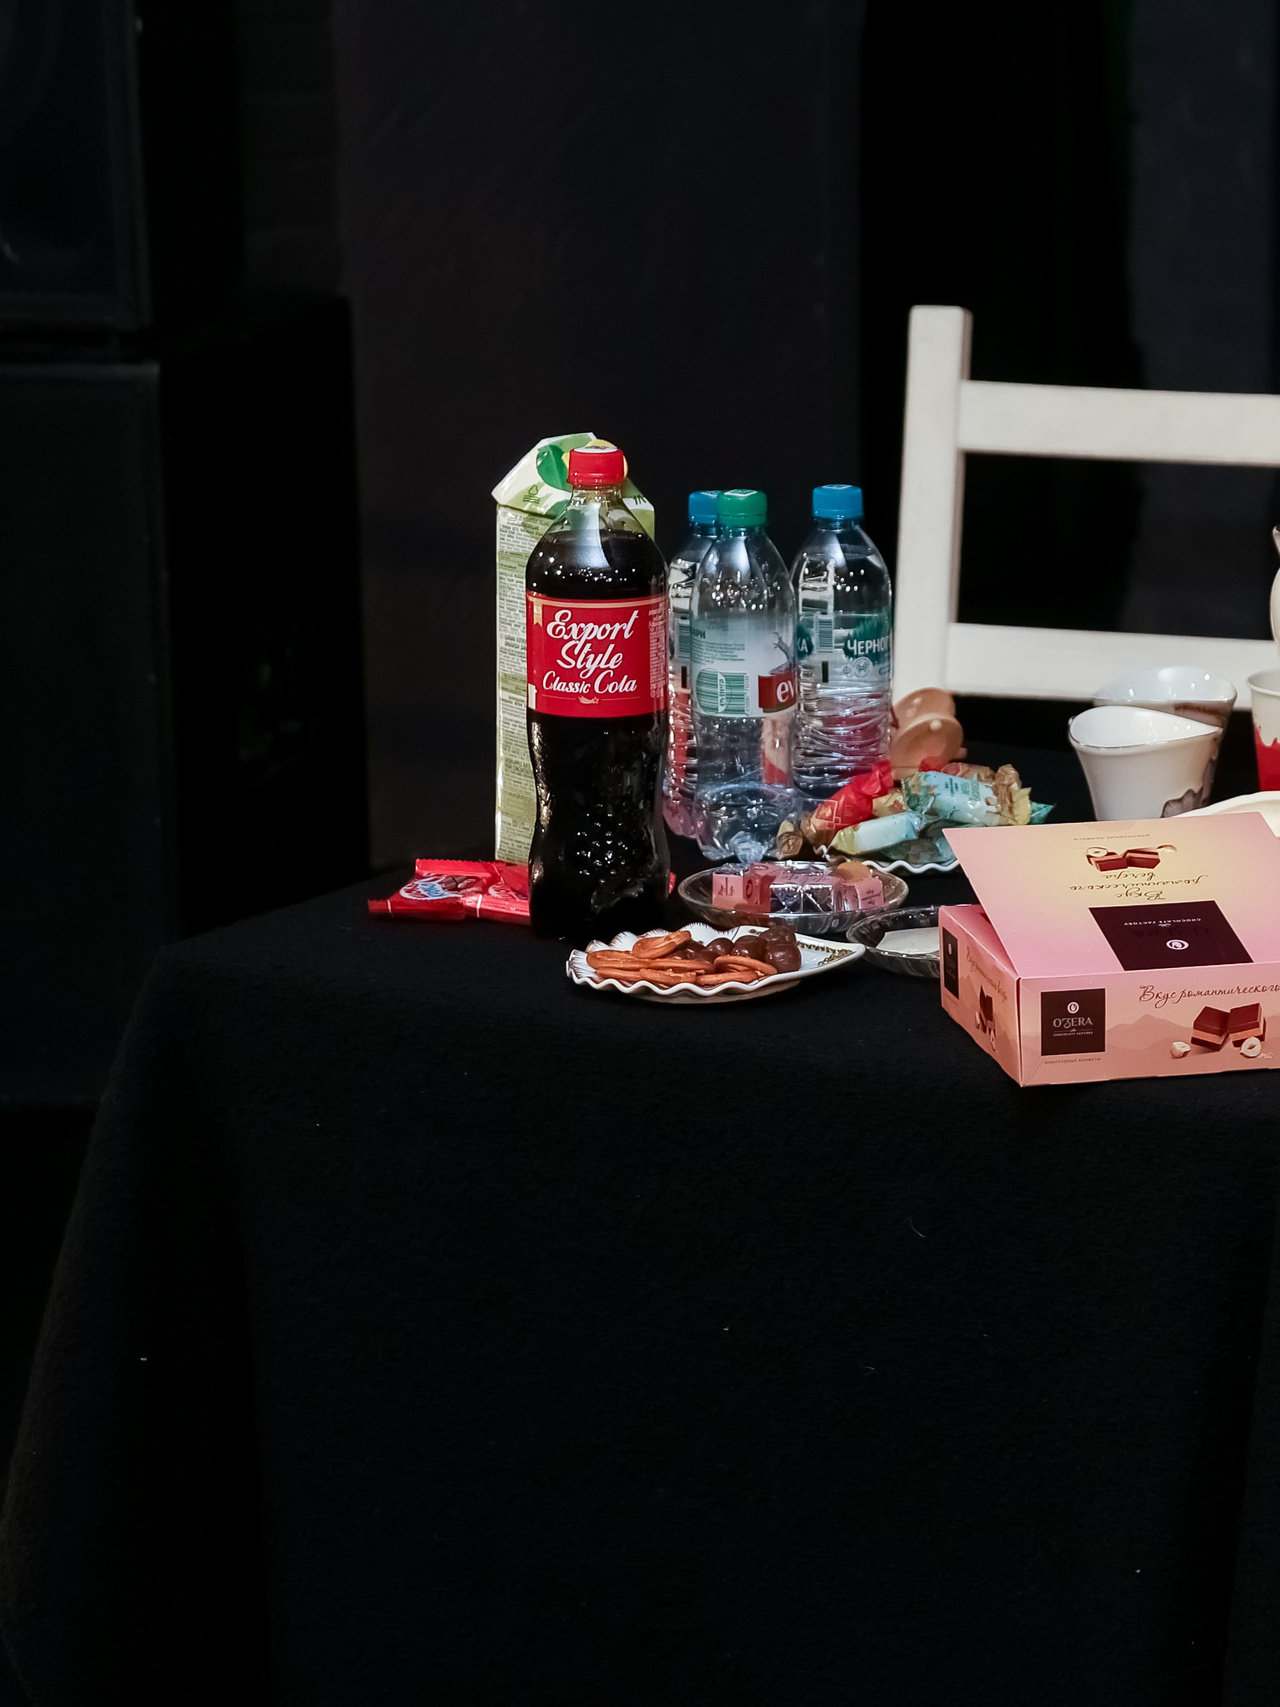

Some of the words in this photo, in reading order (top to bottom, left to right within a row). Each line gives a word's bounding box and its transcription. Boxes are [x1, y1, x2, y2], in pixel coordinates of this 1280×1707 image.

[546, 609, 639, 655] Export
[556, 639, 623, 679] Style
[542, 670, 591, 693] Classic
[593, 669, 638, 694] Cola
[1114, 887, 1166, 900] Вкус
[1138, 984, 1176, 1009] Вкус
[1173, 984, 1280, 1004] романтического
